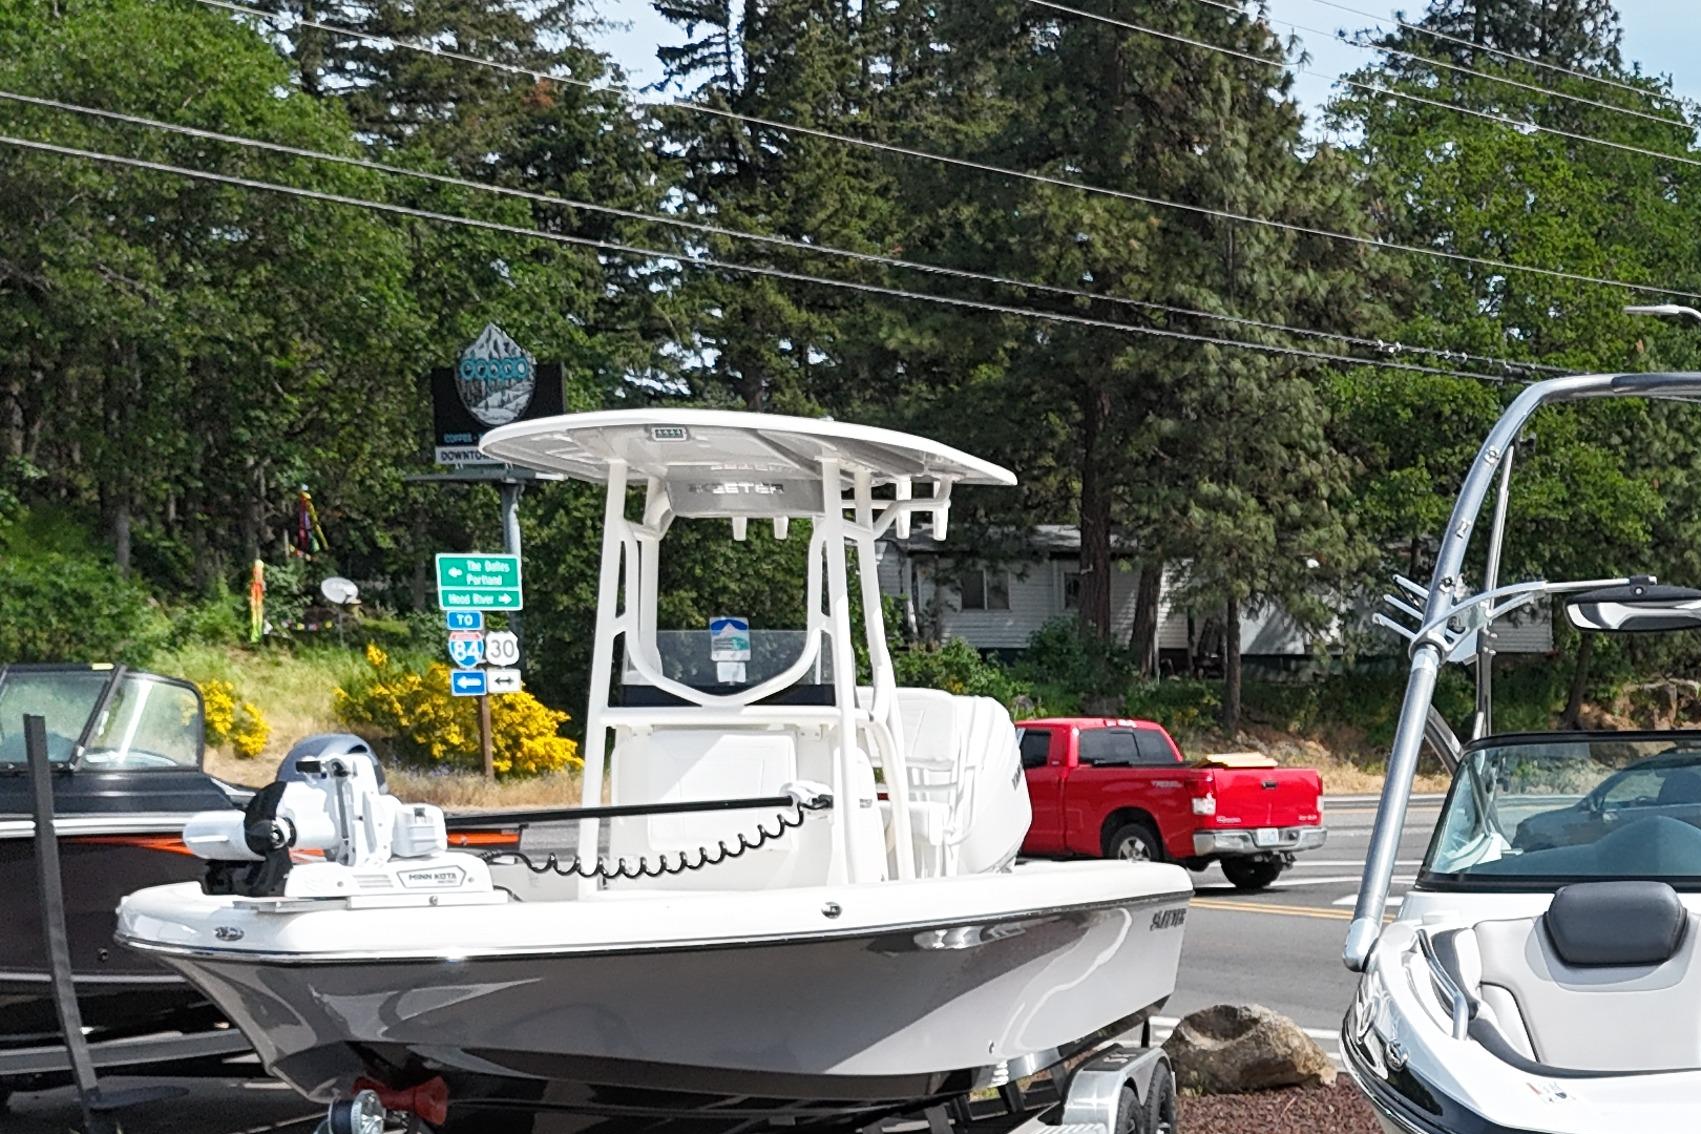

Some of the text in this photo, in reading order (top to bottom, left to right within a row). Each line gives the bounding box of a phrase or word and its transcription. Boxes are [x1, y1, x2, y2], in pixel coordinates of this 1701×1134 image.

[456, 614, 473, 626] TO
[453, 640, 480, 661] 84
[490, 639, 514, 658] 30
